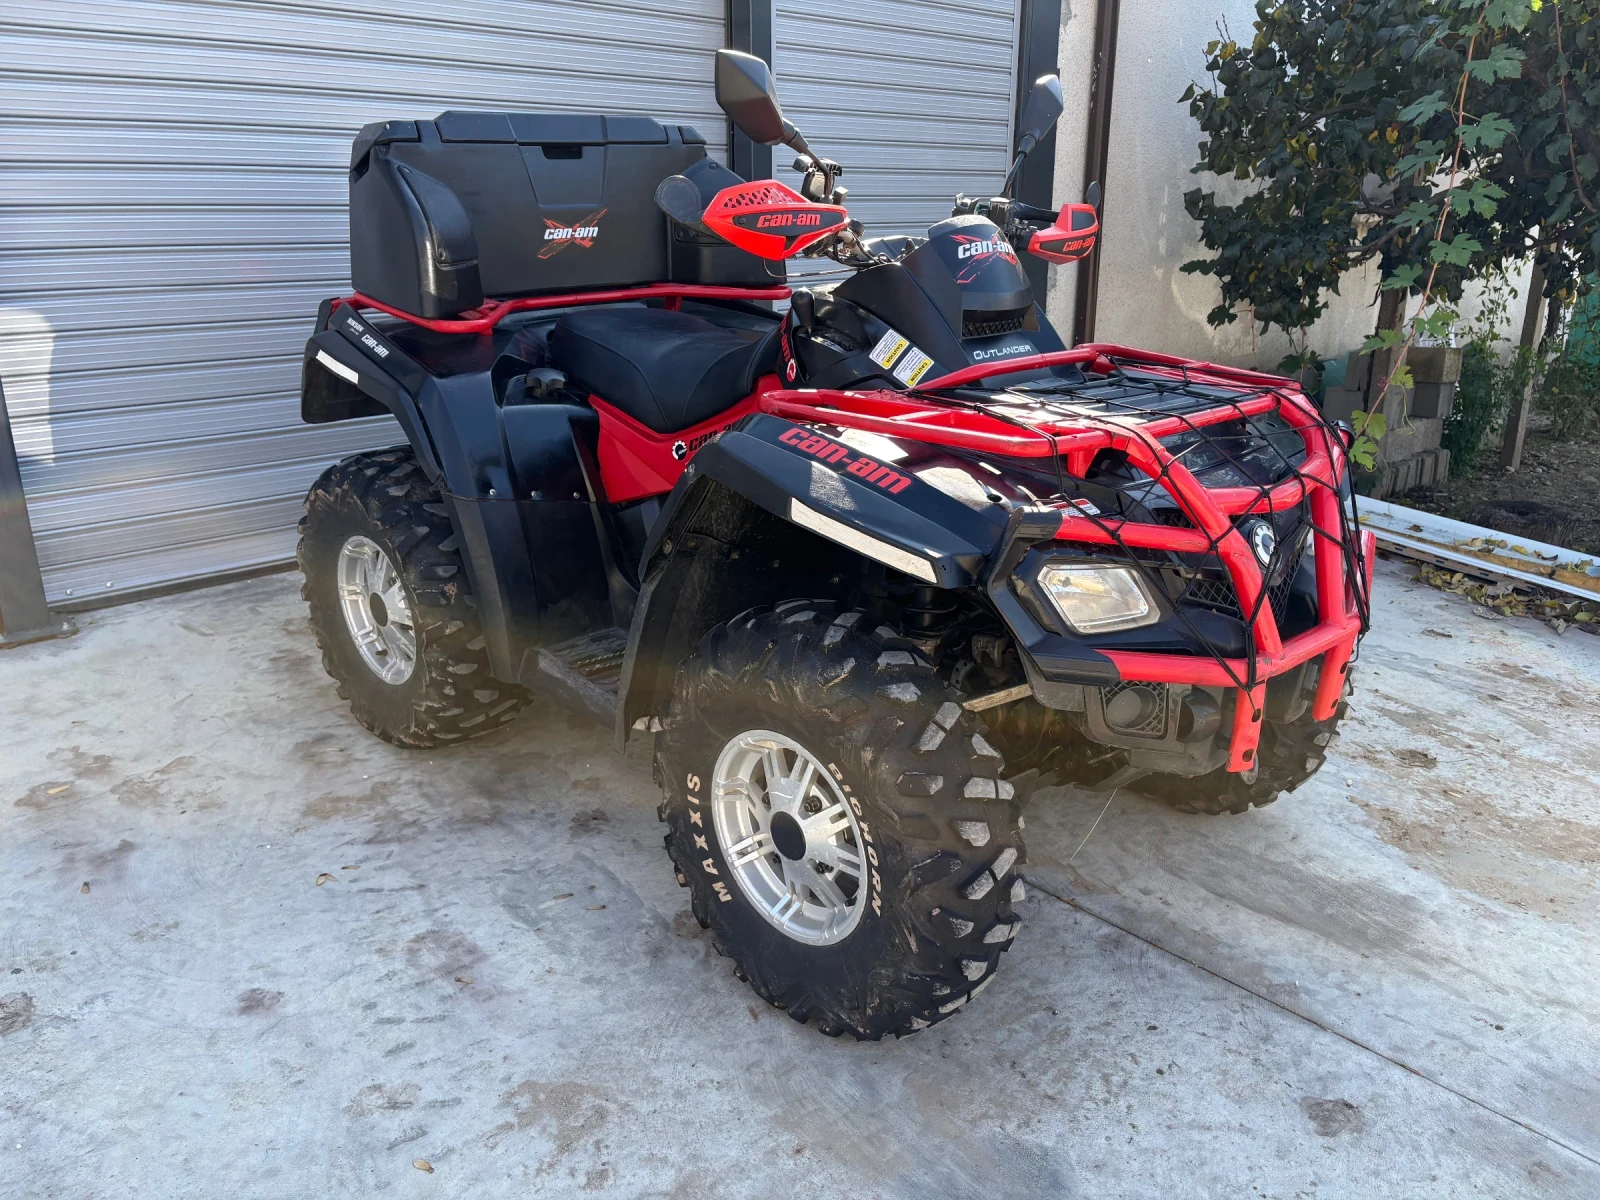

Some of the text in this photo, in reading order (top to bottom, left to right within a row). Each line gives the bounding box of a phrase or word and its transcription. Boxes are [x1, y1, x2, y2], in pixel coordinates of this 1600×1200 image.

[757, 213, 820, 228] can-am
[544, 226, 598, 240] can-am
[361, 333, 389, 358] can-am
[886, 343, 903, 364] CAUTION
[910, 361, 928, 382] CAUTION
[778, 427, 912, 494] can-am
[686, 772, 732, 903] MAXXIS
[827, 762, 882, 917] BIGHORN
